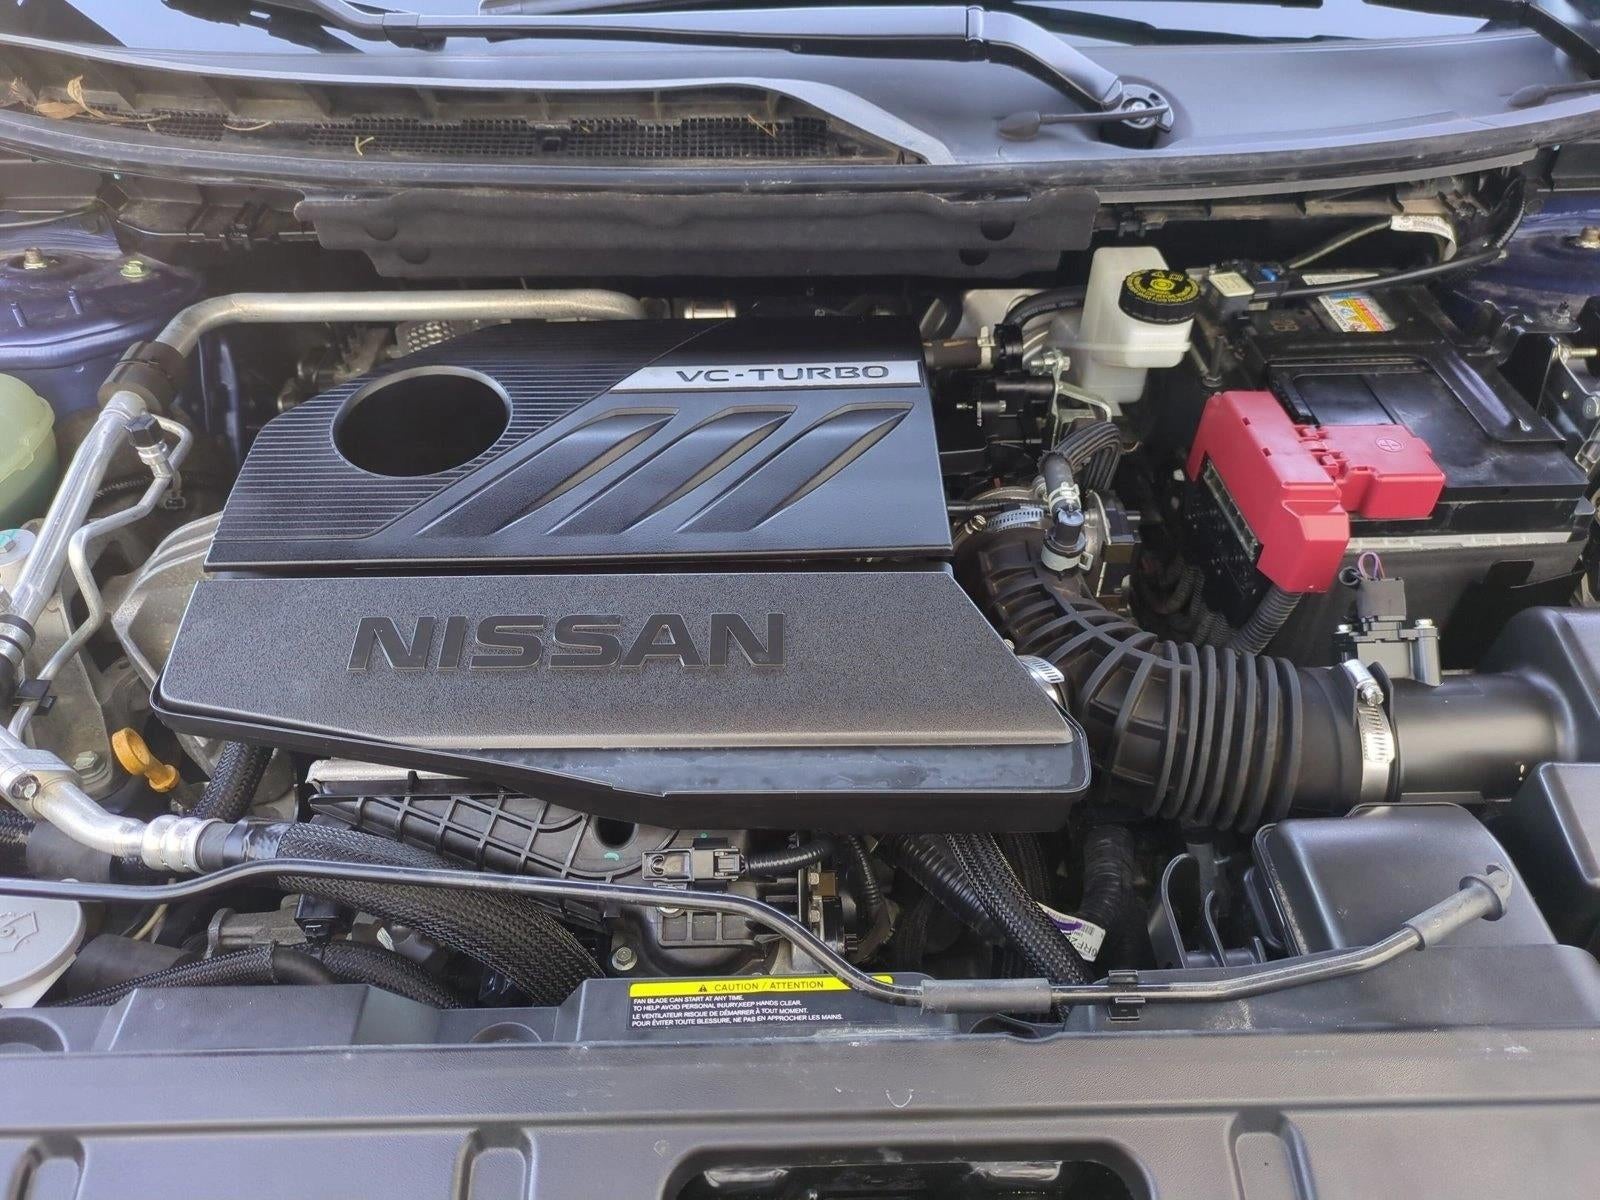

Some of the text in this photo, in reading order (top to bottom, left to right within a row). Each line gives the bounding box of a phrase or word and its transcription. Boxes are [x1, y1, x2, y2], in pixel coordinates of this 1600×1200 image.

[676, 365, 889, 382] VC-TURBO
[346, 612, 786, 671] NISSAN
[714, 983, 758, 992] CAUTION
[770, 981, 824, 990] ATTENTION
